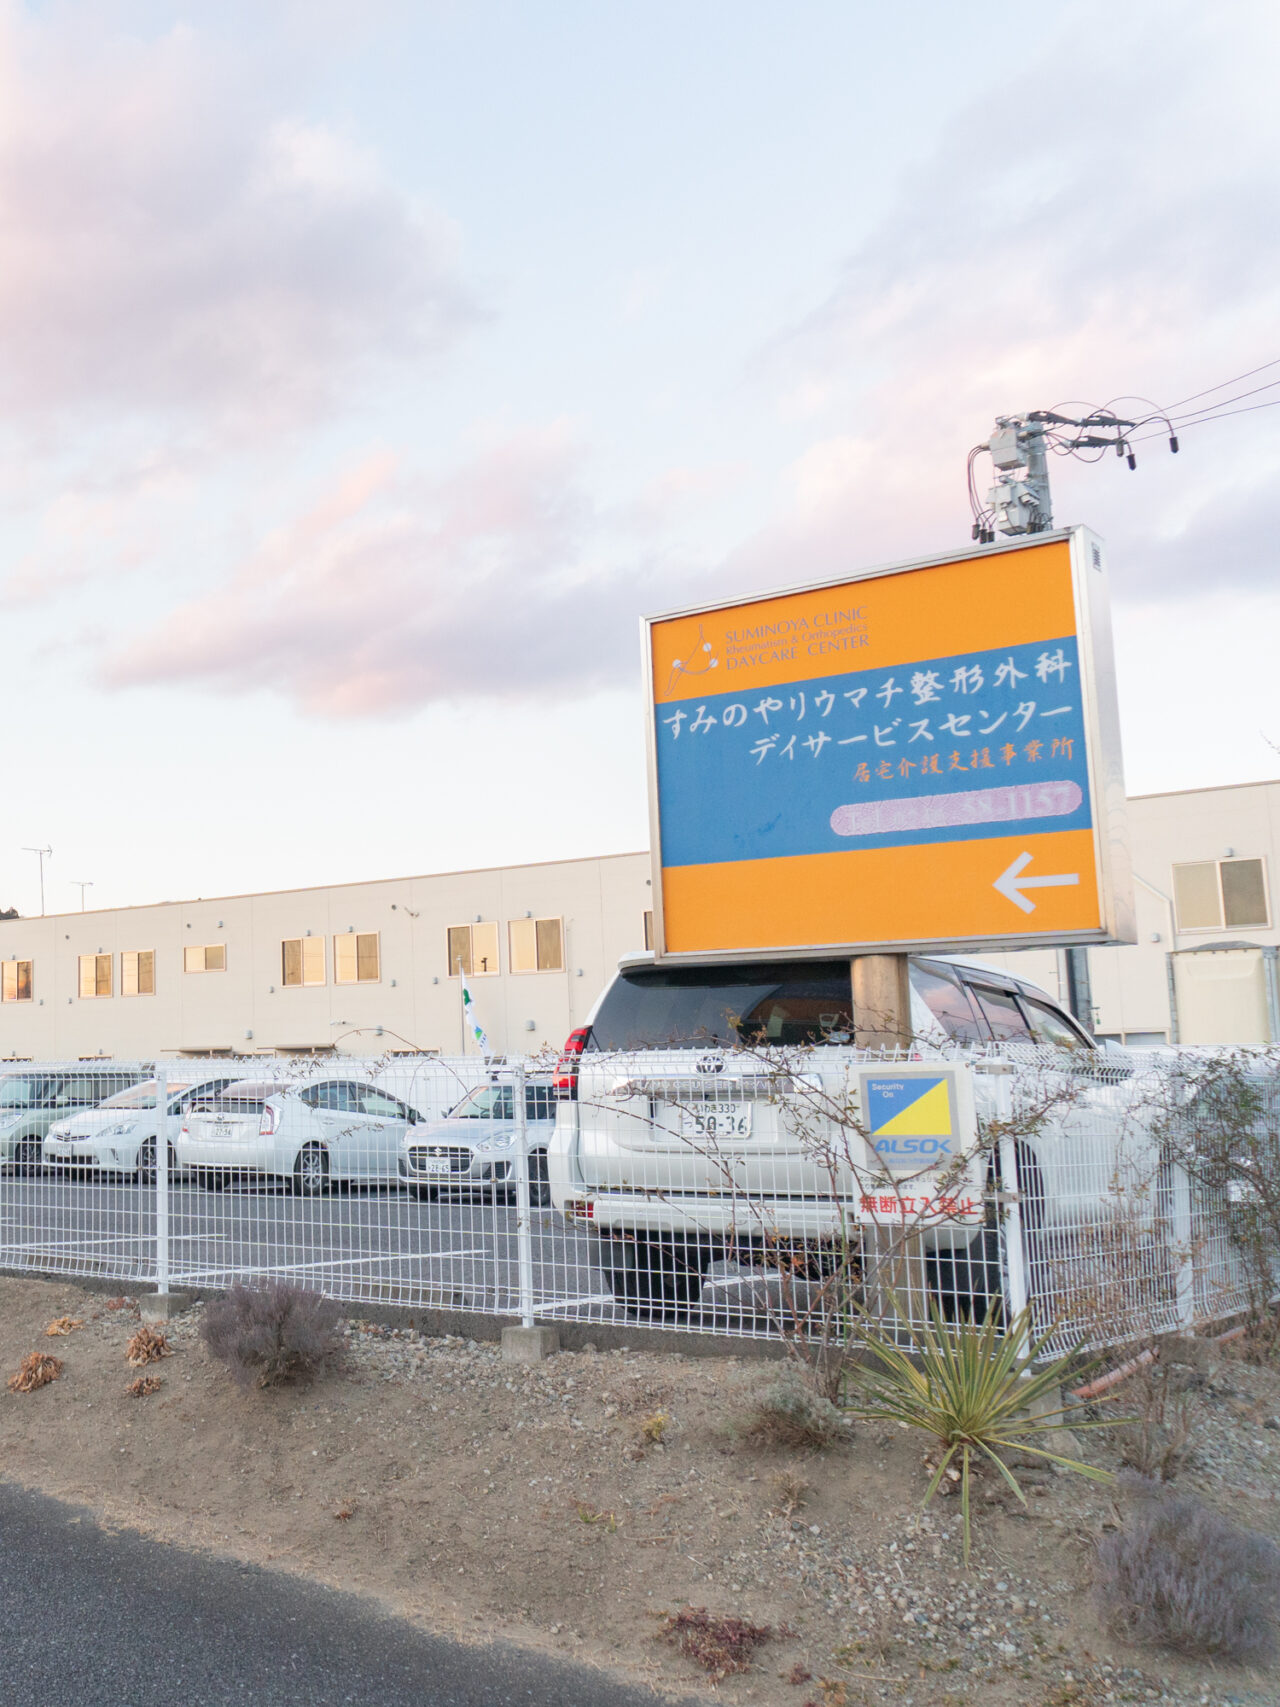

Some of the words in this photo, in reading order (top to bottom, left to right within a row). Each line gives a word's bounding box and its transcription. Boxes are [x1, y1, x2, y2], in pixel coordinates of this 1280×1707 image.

[725, 617, 809, 644] SUMINOYA
[813, 605, 869, 628] CLINIC
[726, 638, 788, 656] Rheumatism
[790, 635, 799, 644] &
[802, 623, 868, 642] Orthopedics
[726, 646, 799, 670] DAYCARE
[807, 634, 870, 656] CENTER
[749, 700, 1074, 766] デイサービスセンター
[852, 737, 1075, 783] 居宅介護支援事業所
[871, 1083, 905, 1091] Security
[874, 1138, 953, 1154] ALSOK
[859, 1195, 979, 1215] 無断立入禁止
